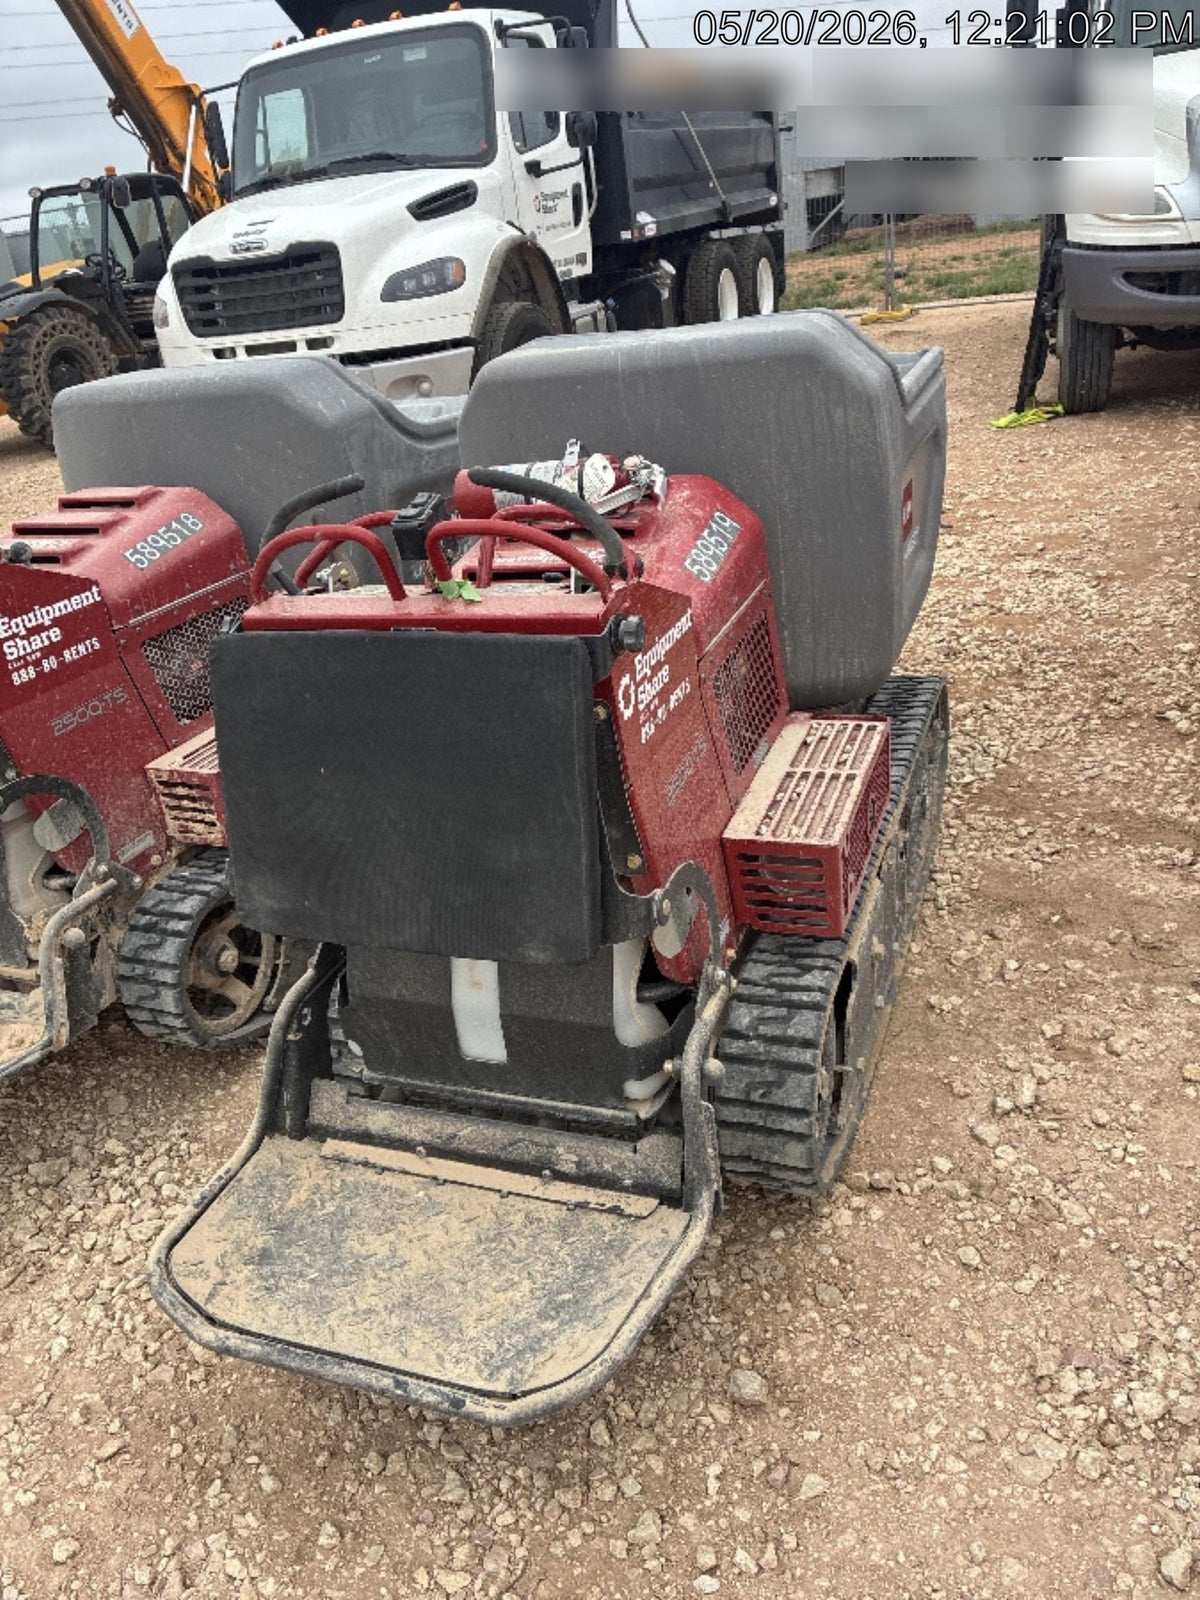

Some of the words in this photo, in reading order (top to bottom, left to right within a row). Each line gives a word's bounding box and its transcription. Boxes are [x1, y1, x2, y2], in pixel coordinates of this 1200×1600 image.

[124, 513, 203, 568] 589518
[684, 512, 740, 582] 589519
[0, 585, 101, 638] Equipment
[3, 626, 62, 660] Share
[634, 607, 693, 682] Equipment
[637, 664, 670, 712] Share
